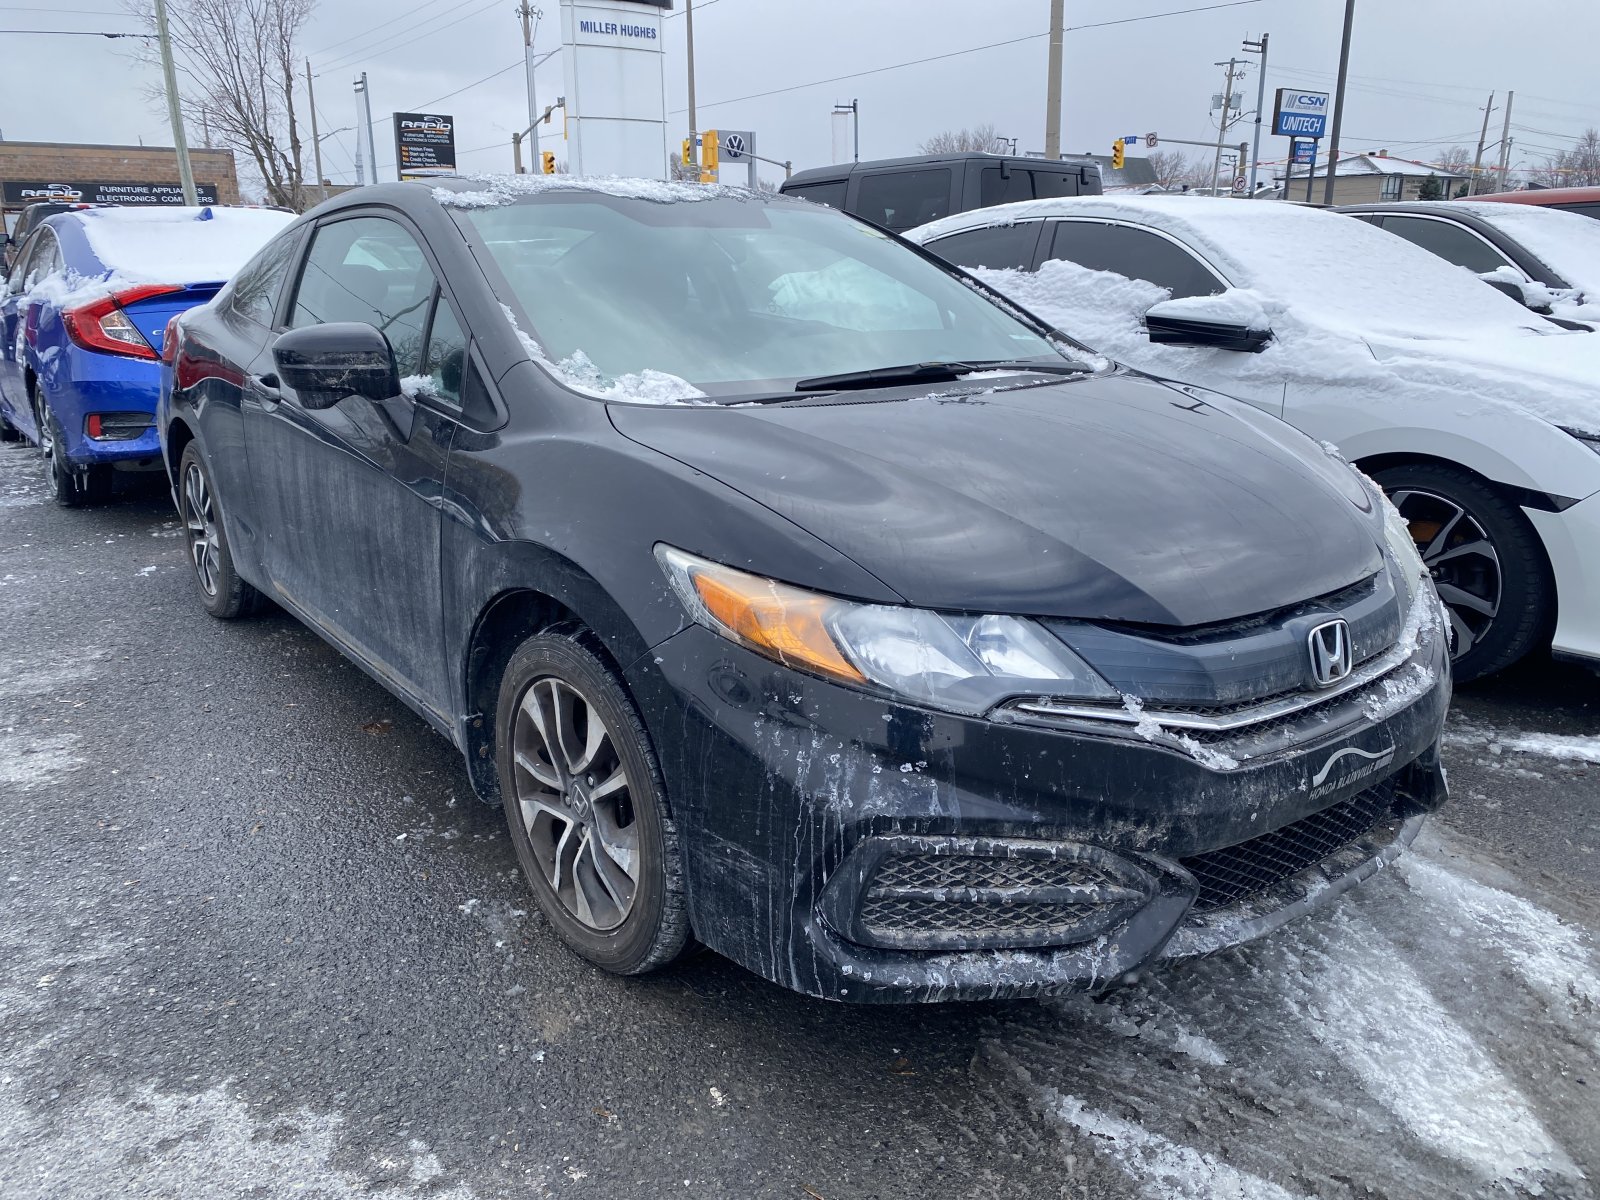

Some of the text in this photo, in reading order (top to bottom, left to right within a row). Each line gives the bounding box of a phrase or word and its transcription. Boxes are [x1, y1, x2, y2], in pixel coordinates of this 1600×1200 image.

[580, 21, 657, 40] MILLER HUGHES
[1298, 95, 1326, 106] CSN
[401, 120, 451, 129] RAPID
[1282, 116, 1322, 132] UNITECH
[99, 185, 149, 193] FURNITURE
[96, 194, 214, 203] ELECTRONICS COMERS
[1309, 762, 1375, 800] HONDA BLAINVILLE
